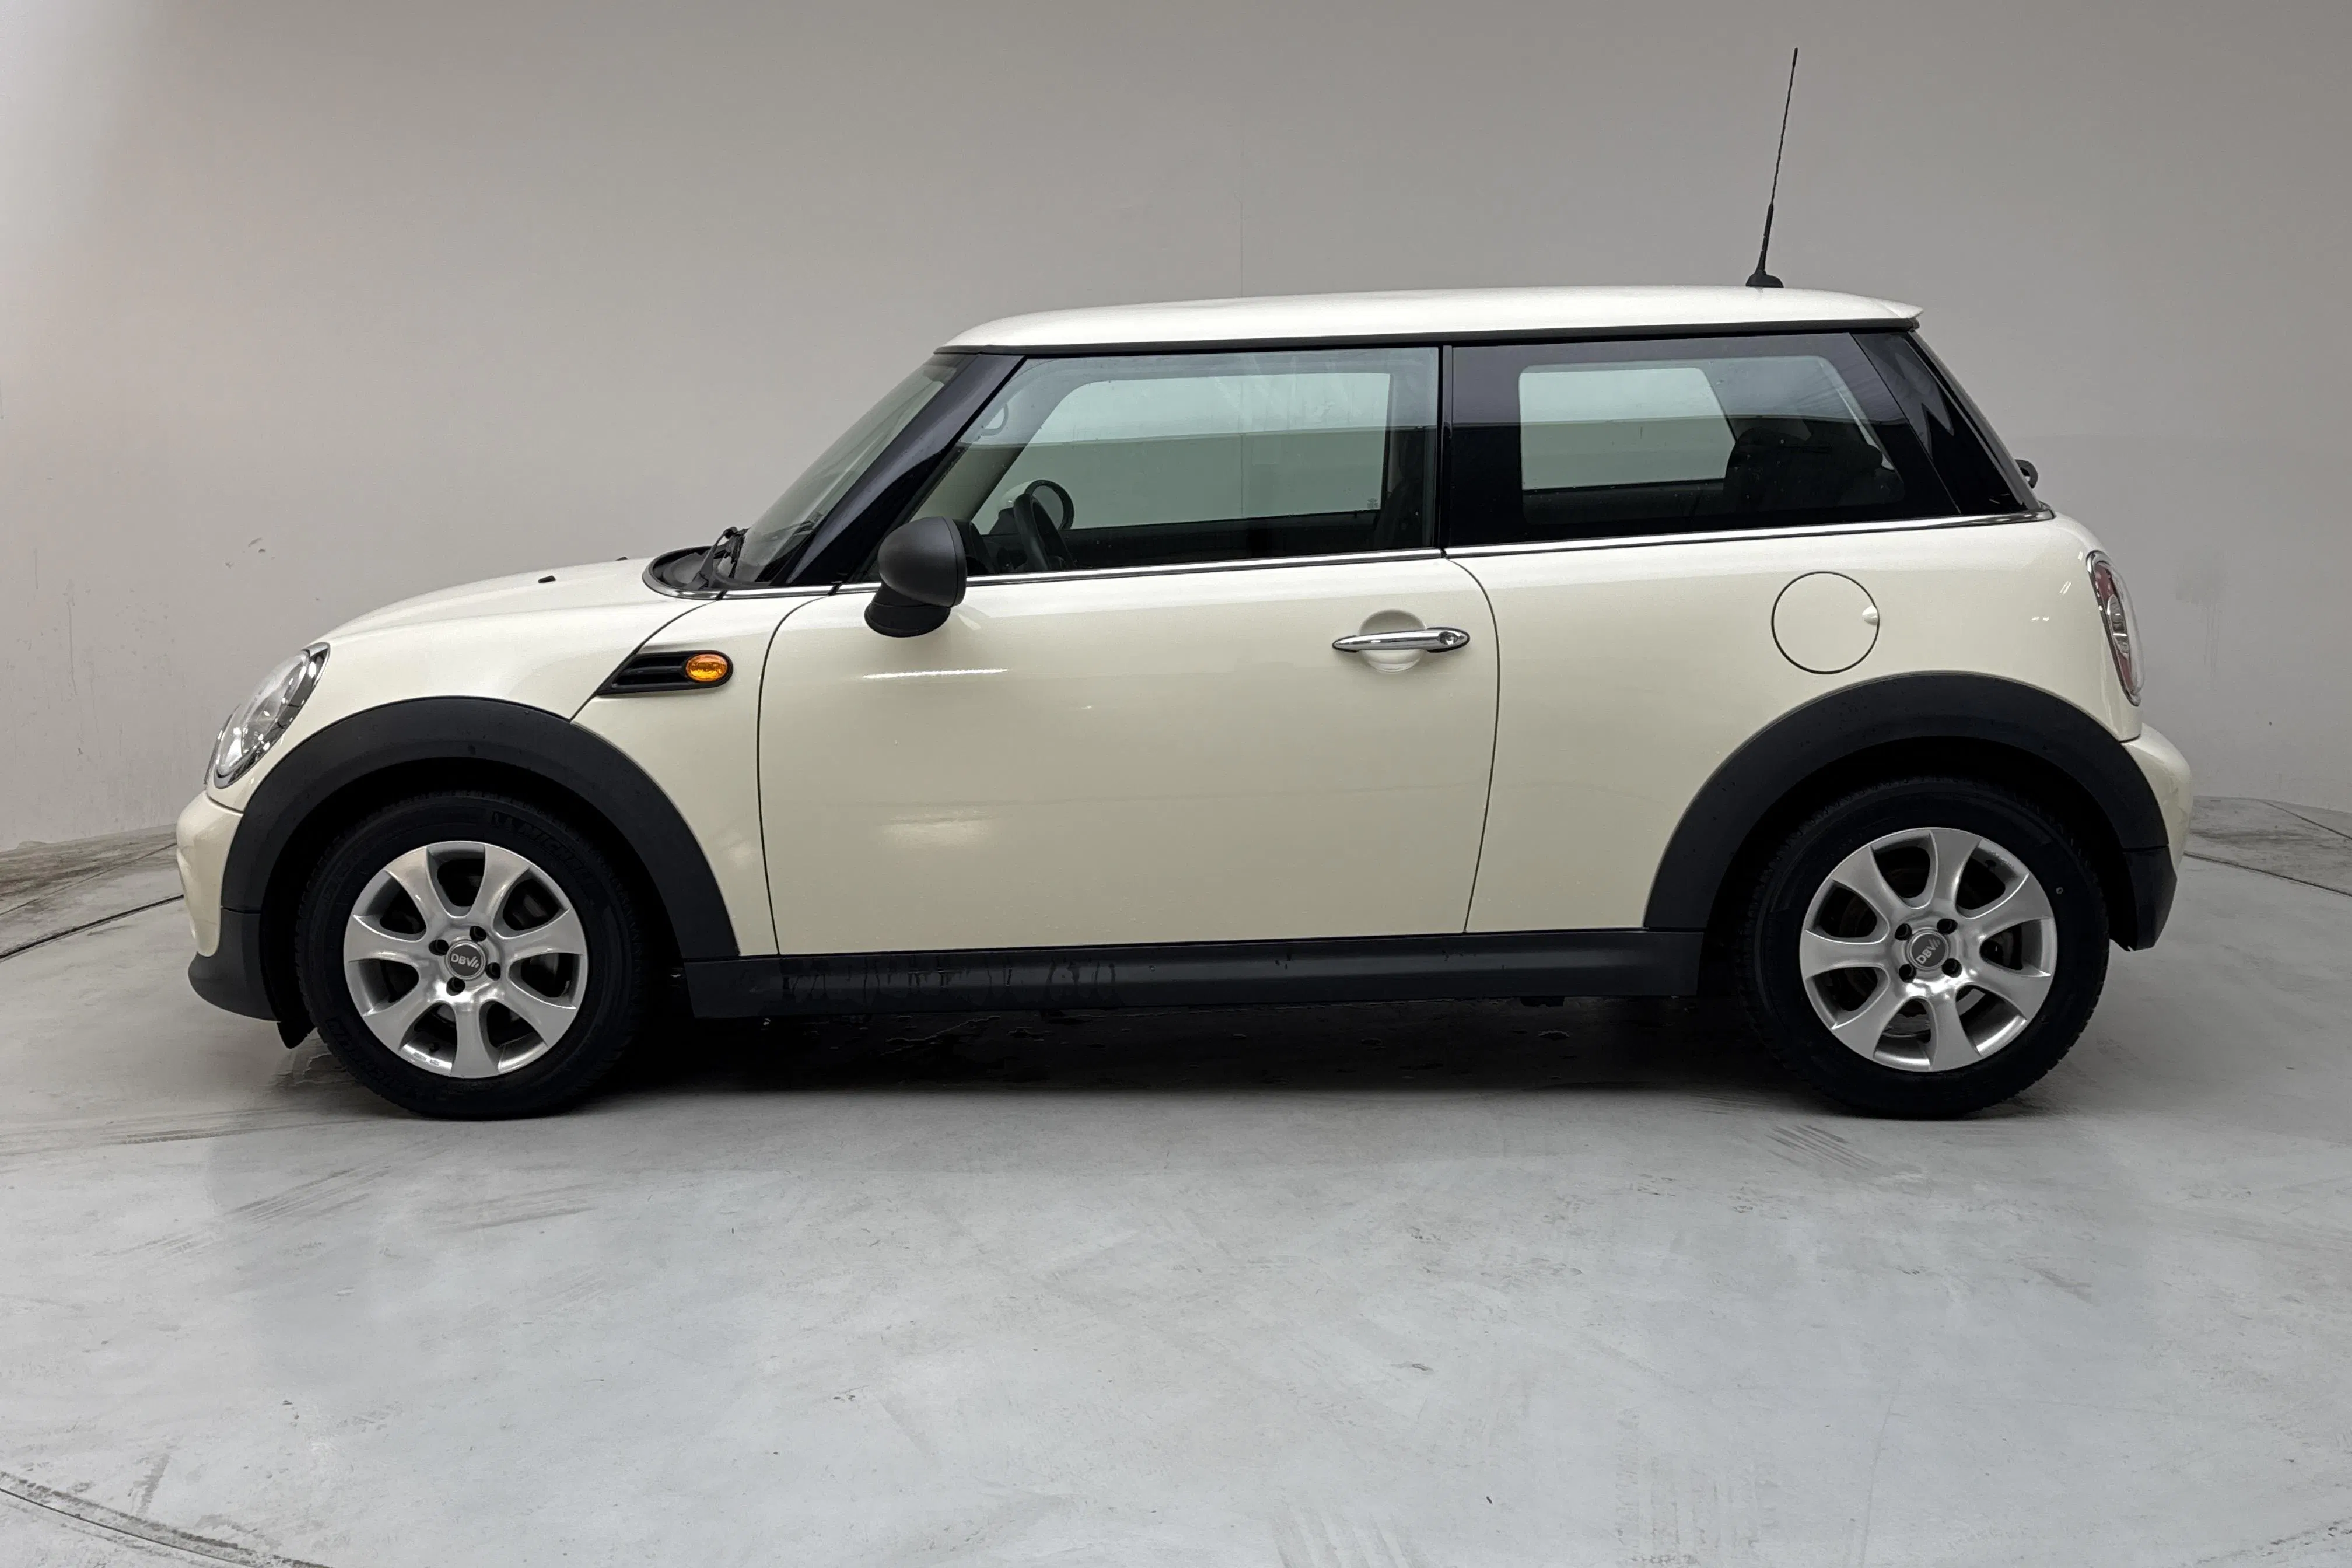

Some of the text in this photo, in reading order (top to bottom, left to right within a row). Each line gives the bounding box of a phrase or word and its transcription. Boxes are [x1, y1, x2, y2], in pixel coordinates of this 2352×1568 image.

[517, 821, 600, 898] MICHEL
[451, 953, 480, 968] DBV
[1916, 938, 1941, 964] DBV
